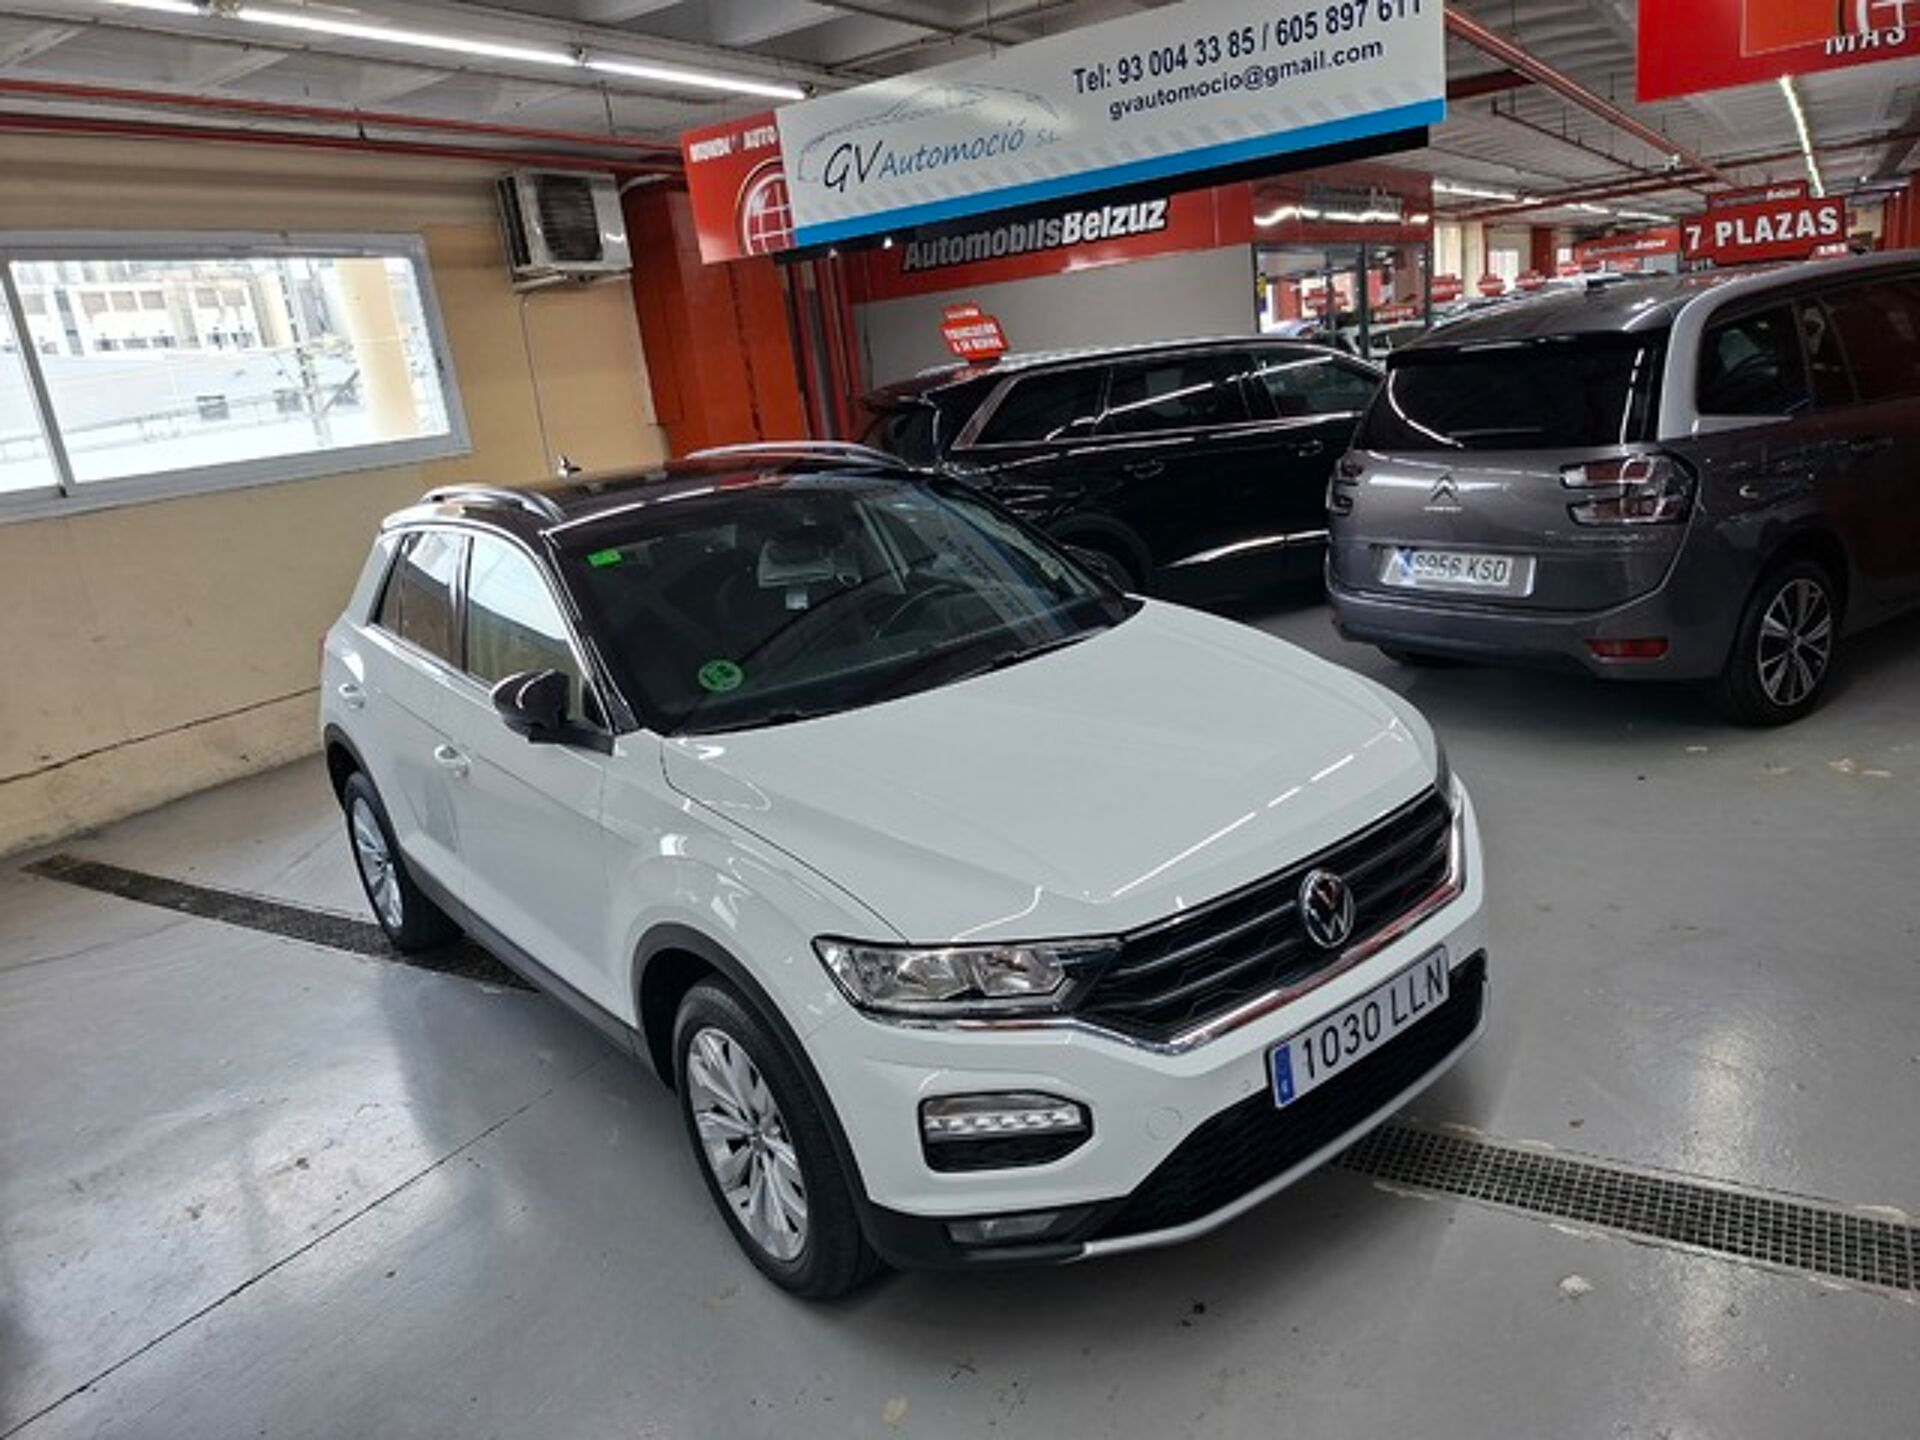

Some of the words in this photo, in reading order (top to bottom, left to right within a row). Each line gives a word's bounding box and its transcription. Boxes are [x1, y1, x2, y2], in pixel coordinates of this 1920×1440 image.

[1073, 63, 1111, 94] Tel:
[1118, 54, 1143, 84] 93
[1149, 44, 1188, 77] 004
[1194, 35, 1221, 66] 33
[1226, 27, 1255, 58] 85
[1262, 22, 1270, 52] /
[1276, 11, 1318, 46] 605
[1326, 0, 1367, 34] 897
[1109, 41, 1383, 121] gvautomocio@gmail.com
[1685, 225, 1701, 250] 7
[1715, 206, 1839, 247] PLAZAS
[1467, 556, 1507, 583] KSD
[1303, 1001, 1381, 1078] 1030
[1391, 956, 1445, 1026] LLN
